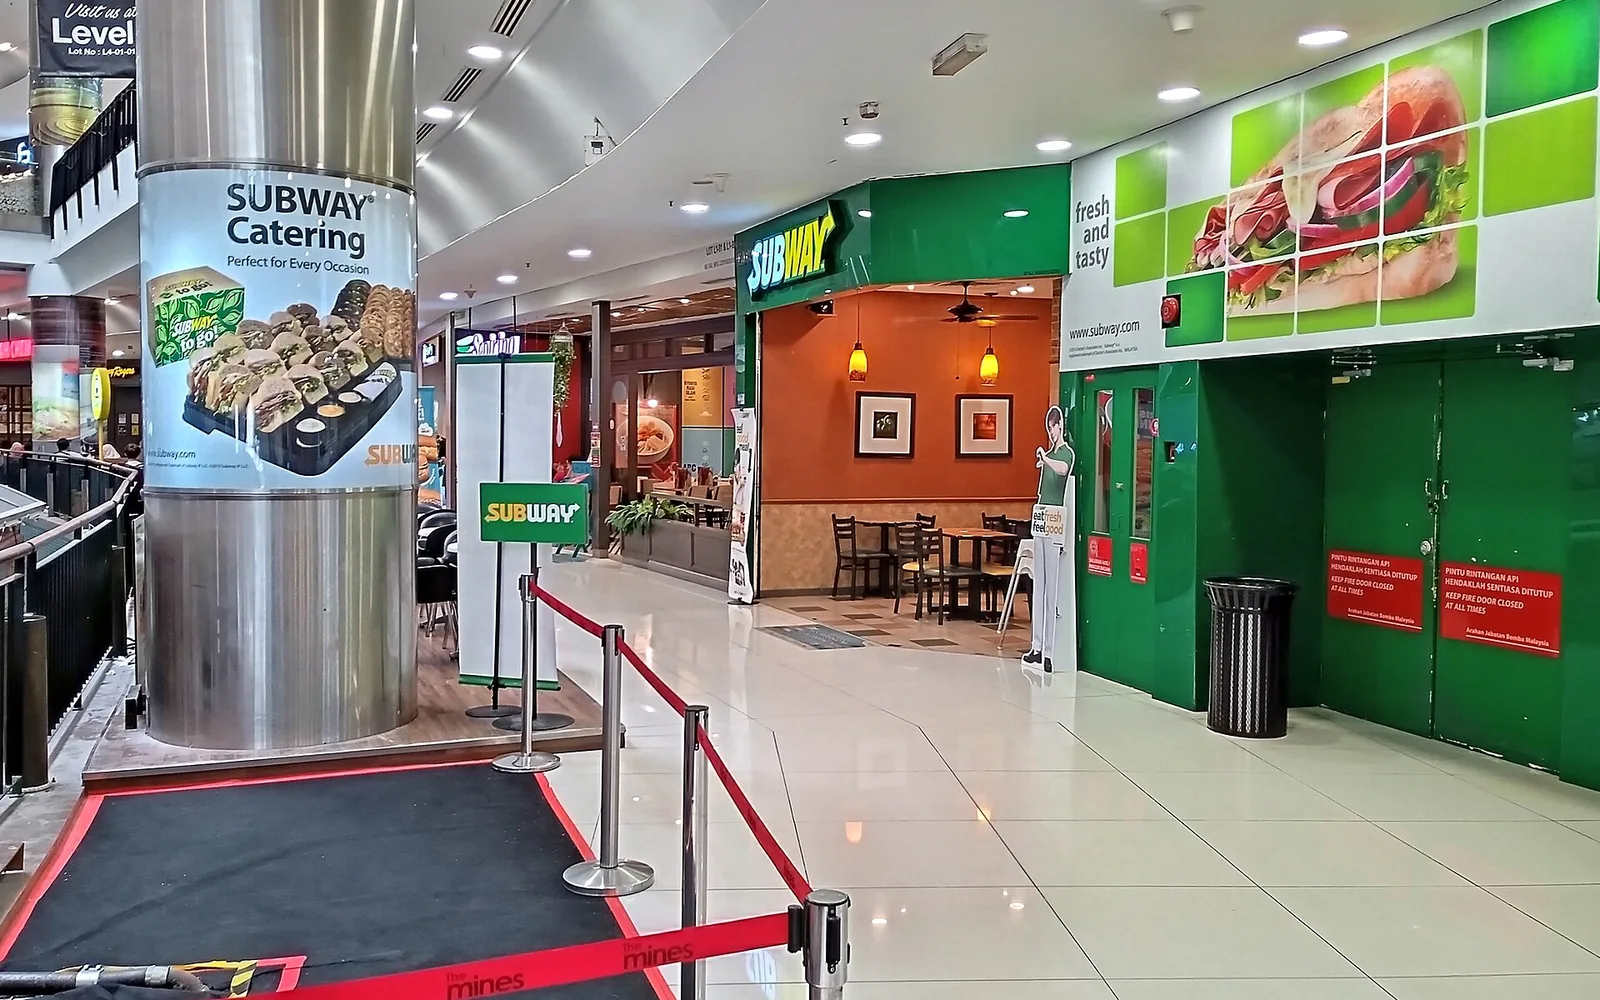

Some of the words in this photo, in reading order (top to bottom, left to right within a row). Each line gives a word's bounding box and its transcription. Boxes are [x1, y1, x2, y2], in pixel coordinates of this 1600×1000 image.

[65, 3, 106, 18] Visit
[104, 8, 120, 18] us
[124, 6, 137, 18] at
[52, 18, 134, 46] Level
[68, 47, 82, 55] Lot
[1075, 194, 1109, 223] fresh
[227, 217, 365, 259] Catering
[1083, 216, 1109, 244] and
[227, 255, 268, 268] Perfect
[270, 257, 287, 268] for
[289, 258, 321, 273] Every
[323, 261, 369, 275] Occasion
[747, 214, 836, 296] SUBWAY
[1075, 246, 1109, 270] tasty
[172, 314, 217, 337] SUBWAY
[1069, 320, 1140, 339] www.subway.com
[181, 338, 195, 352] to
[196, 325, 219, 348] go!
[484, 503, 580, 523] SUBWAY
[1331, 554, 1347, 562] PINTU
[1348, 556, 1380, 566] RINTANGAN
[1331, 563, 1364, 574] HENDAKLAH
[1364, 567, 1391, 577] SENTIASA
[1392, 571, 1418, 581] DITUTUP
[1445, 567, 1465, 577] PINTU
[1466, 570, 1506, 582] RINTANGAN
[1507, 575, 1519, 583] API
[1331, 575, 1344, 583] KEEP
[1344, 577, 1356, 585] FIRE
[1356, 579, 1372, 588] DOOR
[1372, 581, 1394, 591] CLOSED
[1348, 587, 1364, 596] TIMES
[1445, 578, 1486, 590] HENDAKLAH
[1487, 583, 1520, 595] SENTIASA
[1521, 588, 1554, 598] DITUTUP
[1445, 591, 1461, 600] KEEP
[1462, 593, 1476, 603] FIRE
[1477, 595, 1497, 606] DOOR
[1497, 599, 1524, 609] CLOSED
[1454, 603, 1466, 612] ALL
[1467, 604, 1486, 615] TIMES
[1395, 616, 1415, 624] Malaysia
[1466, 627, 1485, 636] Arahan
[1485, 630, 1506, 639] Jabatan
[1506, 633, 1525, 643] Bomba
[1525, 637, 1549, 647] Malaysia
[623, 942, 642, 954] The
[623, 942, 694, 970] mines
[446, 972, 466, 982] The
[446, 973, 525, 1000] mines
